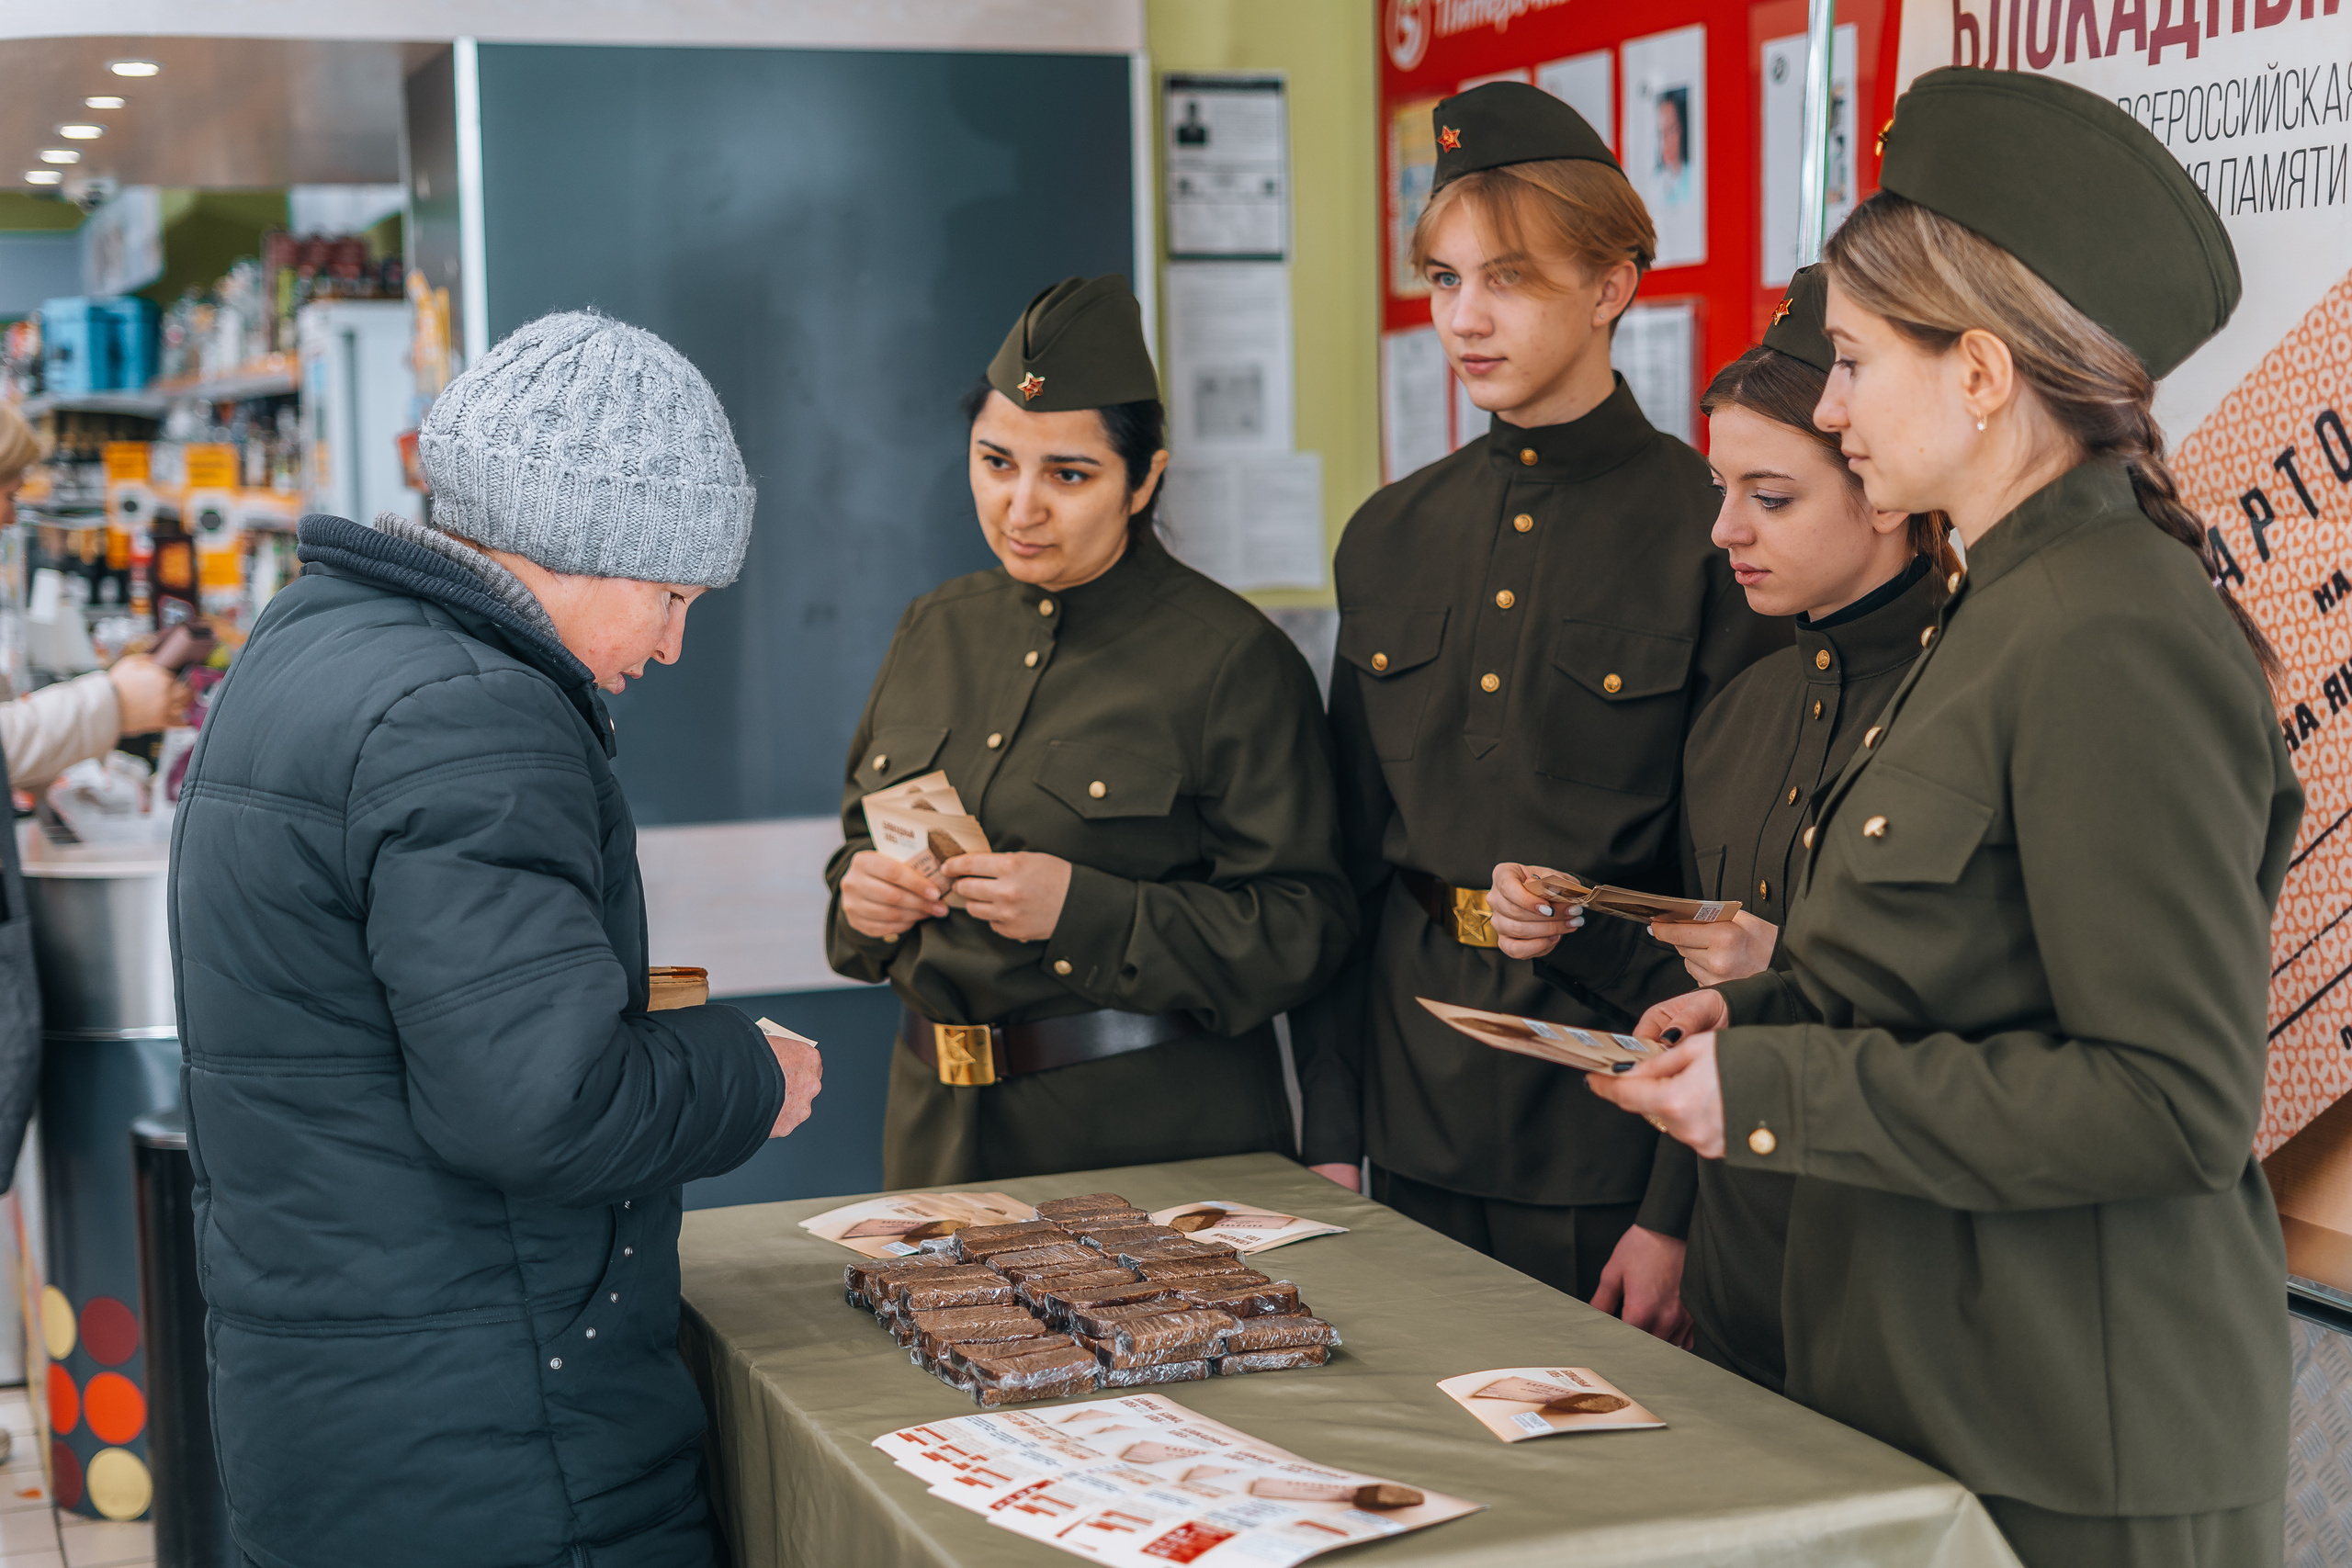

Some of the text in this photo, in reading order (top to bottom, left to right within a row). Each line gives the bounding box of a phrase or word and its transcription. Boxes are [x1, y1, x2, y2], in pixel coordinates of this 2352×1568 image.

[1952, 0, 2340, 70] БЛОКАД
[2217, 142, 2348, 217] ПАМЯТИ
[2313, 569, 2351, 615] НА
